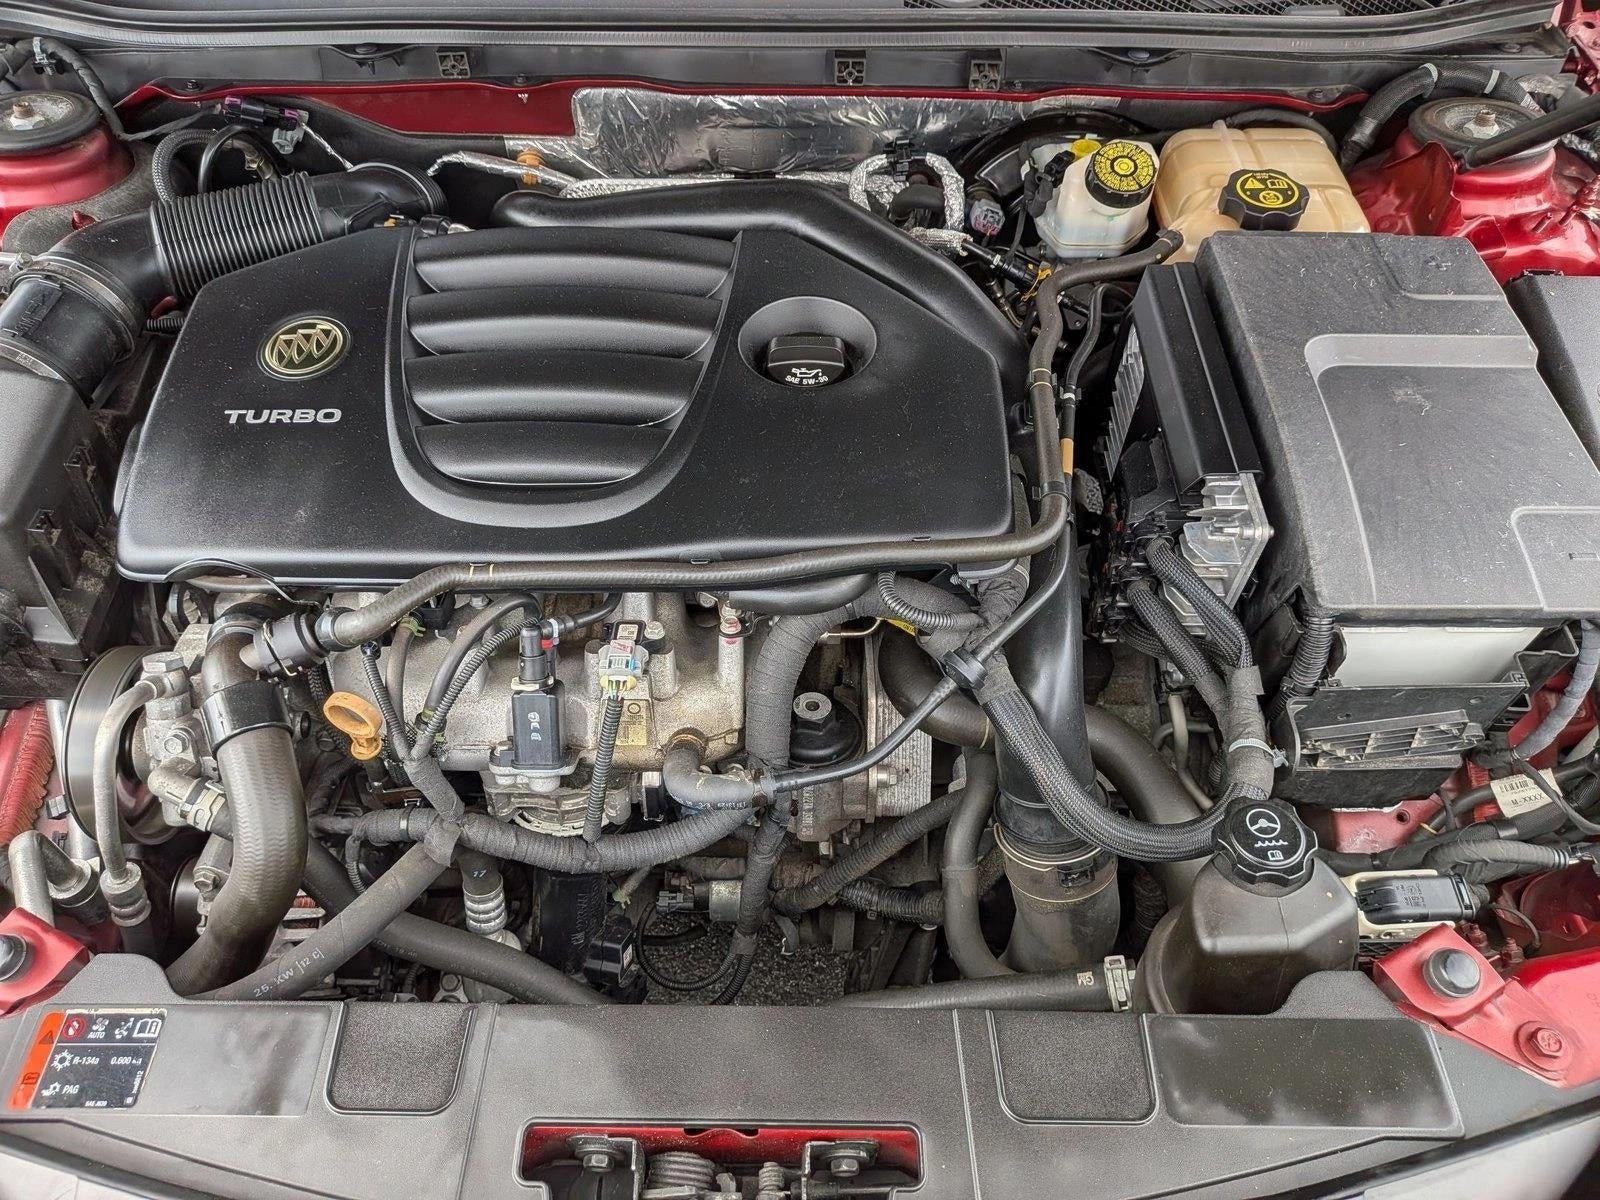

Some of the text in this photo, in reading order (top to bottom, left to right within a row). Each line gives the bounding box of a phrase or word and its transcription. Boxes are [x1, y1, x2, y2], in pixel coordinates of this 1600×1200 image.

[785, 375, 829, 384] SAE 5W-30
[224, 408, 342, 424] TURBO
[72, 1056, 100, 1065] R-134a
[111, 1056, 131, 1065] 0.600
[62, 1085, 79, 1094] PAG
